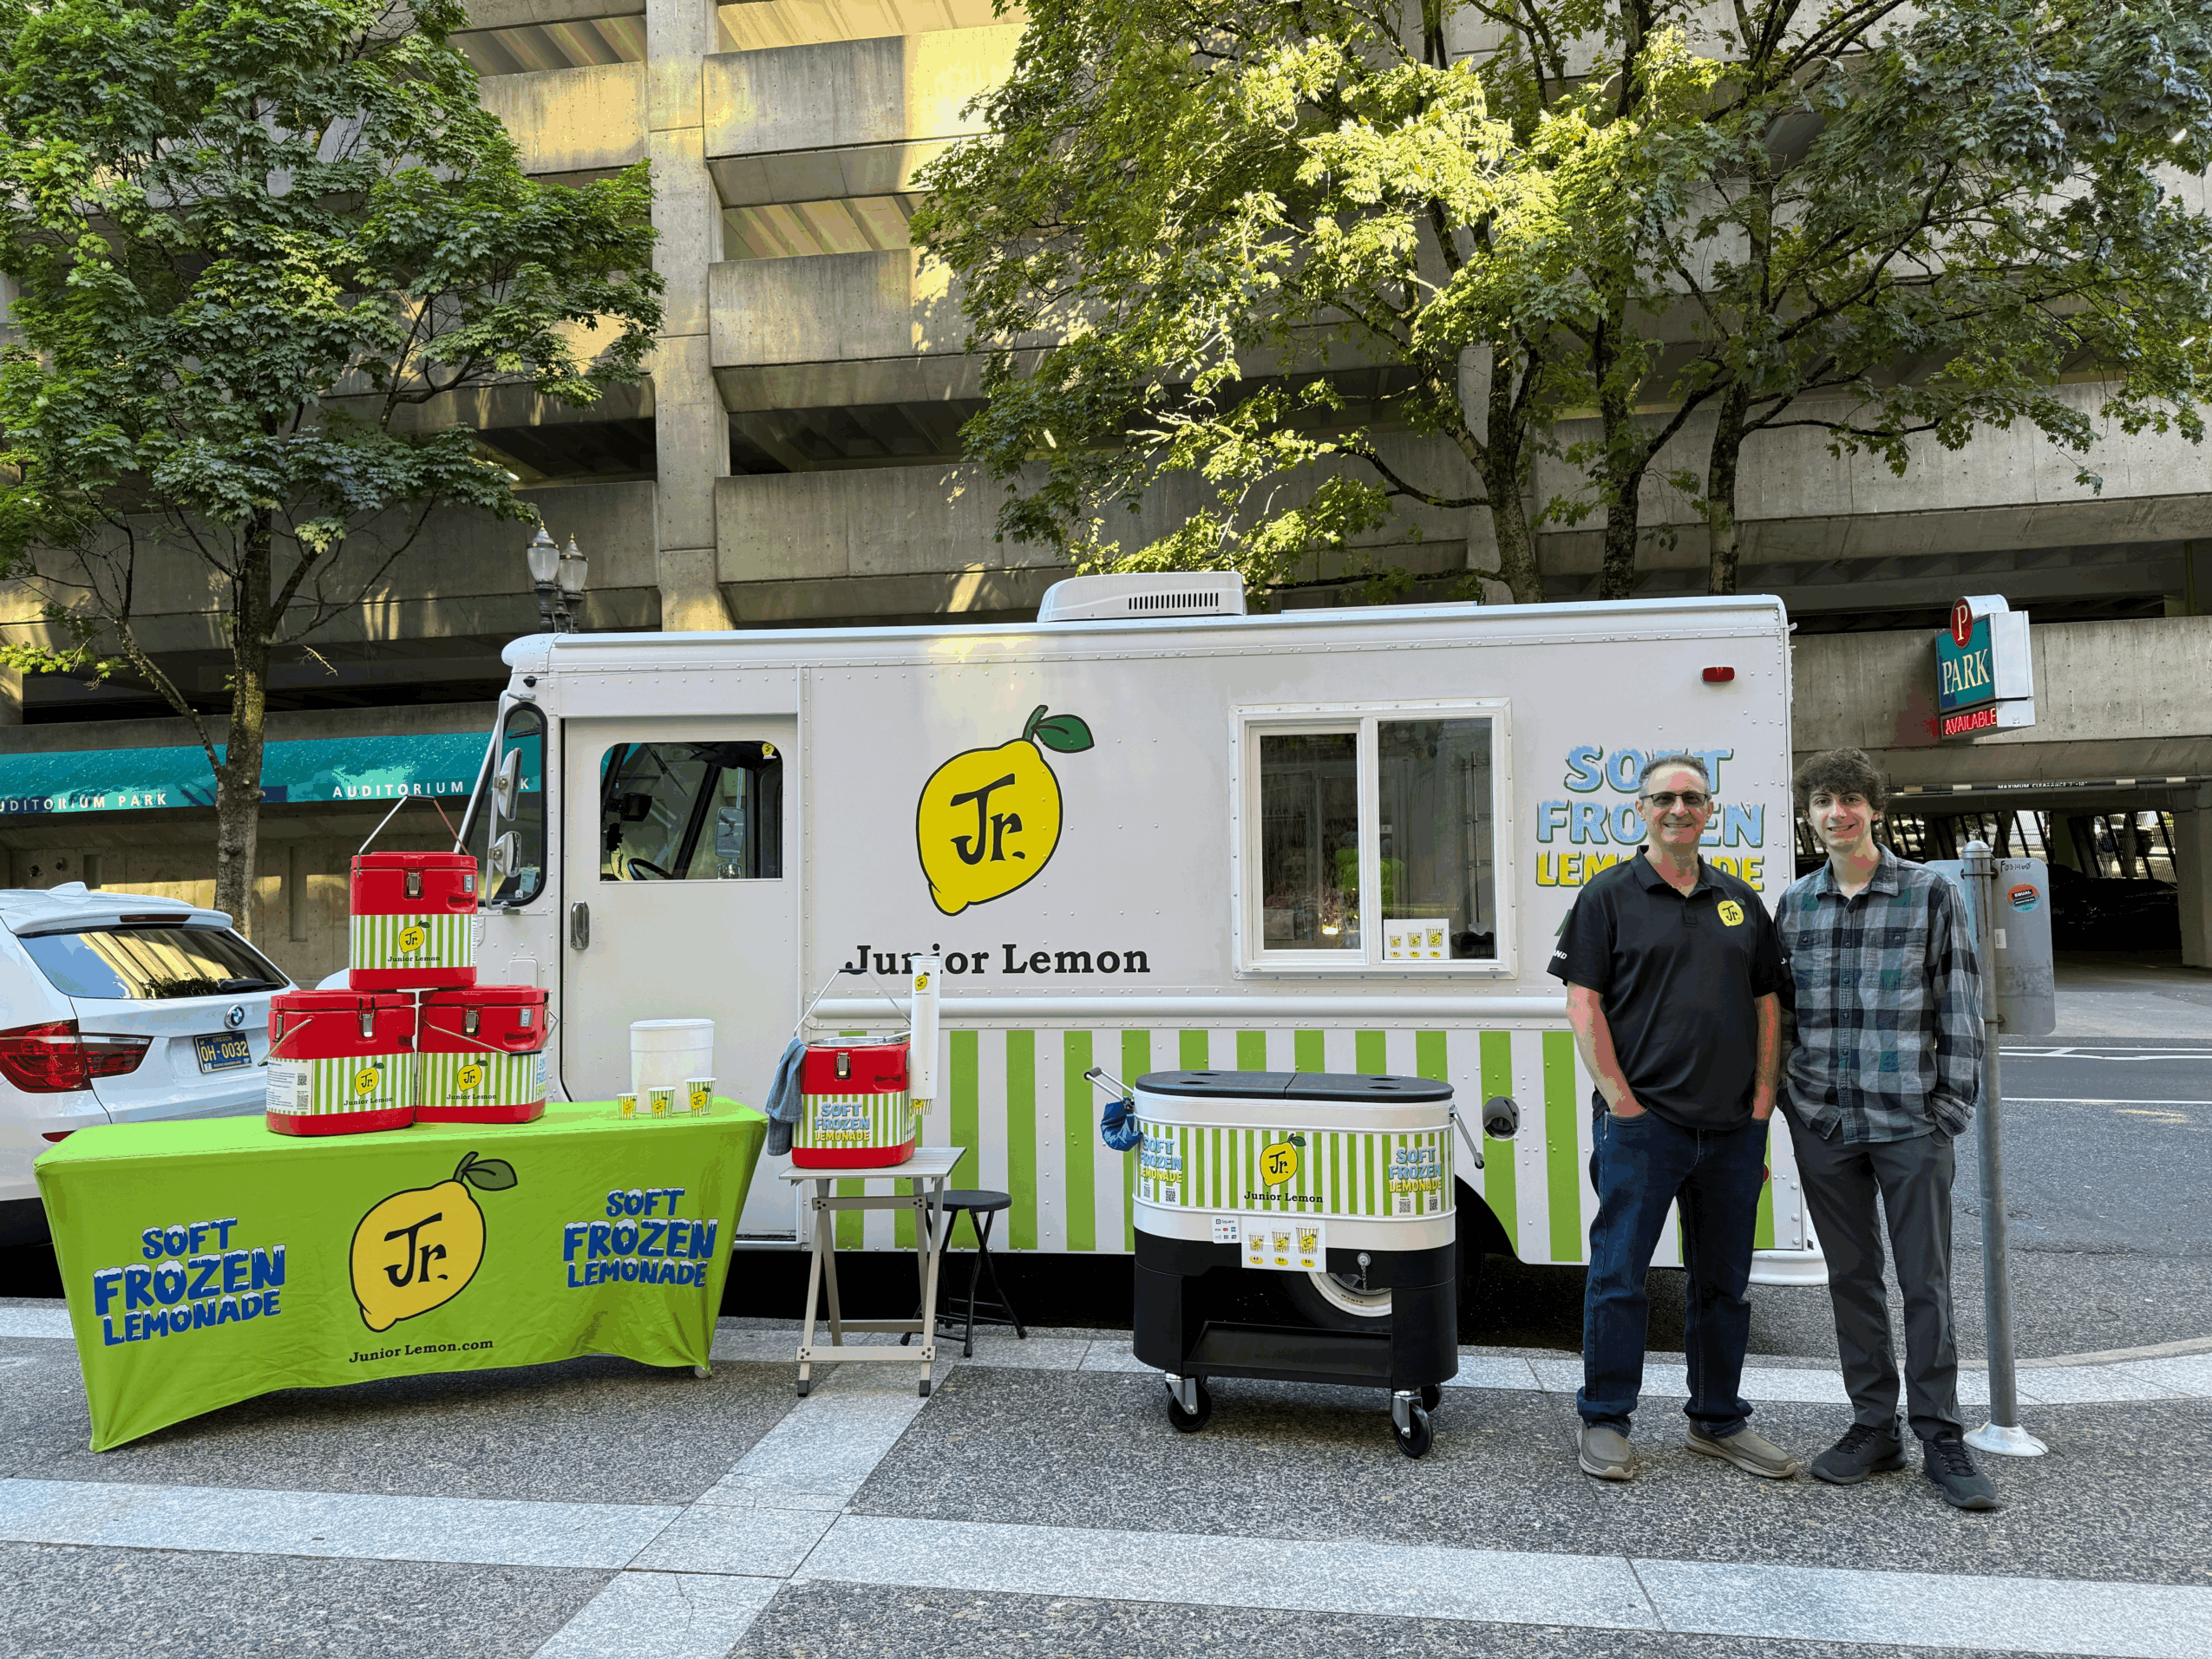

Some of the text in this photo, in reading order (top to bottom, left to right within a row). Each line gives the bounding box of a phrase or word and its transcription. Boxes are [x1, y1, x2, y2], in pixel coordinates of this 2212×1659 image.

[1955, 604, 1968, 642] P
[1941, 648, 1991, 696] PARK
[1945, 708, 1997, 735] AVAILABLE
[1563, 745, 1735, 795] SOT
[118, 793, 167, 807] PARK
[332, 781, 463, 799] AUDITORIUM
[950, 773, 1026, 865] Jr.
[1536, 799, 1766, 848] FROEN
[1535, 850, 1765, 893] LEMDE
[2013, 889, 2032, 898] EQUAL
[1722, 905, 1741, 922] Jr.
[404, 931, 418, 946] Jr.
[1001, 943, 1151, 975] Lemon
[360, 1072, 374, 1088] Jr.
[462, 1069, 476, 1084] Jr.
[344, 1098, 369, 1107] Junior
[821, 1101, 863, 1117] SOFT
[815, 1116, 870, 1131] FROZEN
[815, 1130, 870, 1142] LEMONADE
[1142, 1134, 1175, 1154] SOFT
[1268, 1150, 1289, 1175] Jr.
[1396, 1146, 1436, 1165] SOFT
[1388, 1162, 1442, 1180] FROZEN
[1244, 1191, 1324, 1204] Junior Lemon
[1389, 1179, 1443, 1193] LEMONADE
[605, 1187, 686, 1218] SOFT
[141, 1217, 239, 1260] SOFT
[383, 1212, 448, 1288] Jr.
[563, 1218, 720, 1262] FROZEN
[93, 1244, 287, 1317] FROZEN
[567, 1257, 709, 1289] LEMONADE
[101, 1288, 282, 1347] LEMONADE
[349, 1340, 494, 1363] Junior Lemon.com
